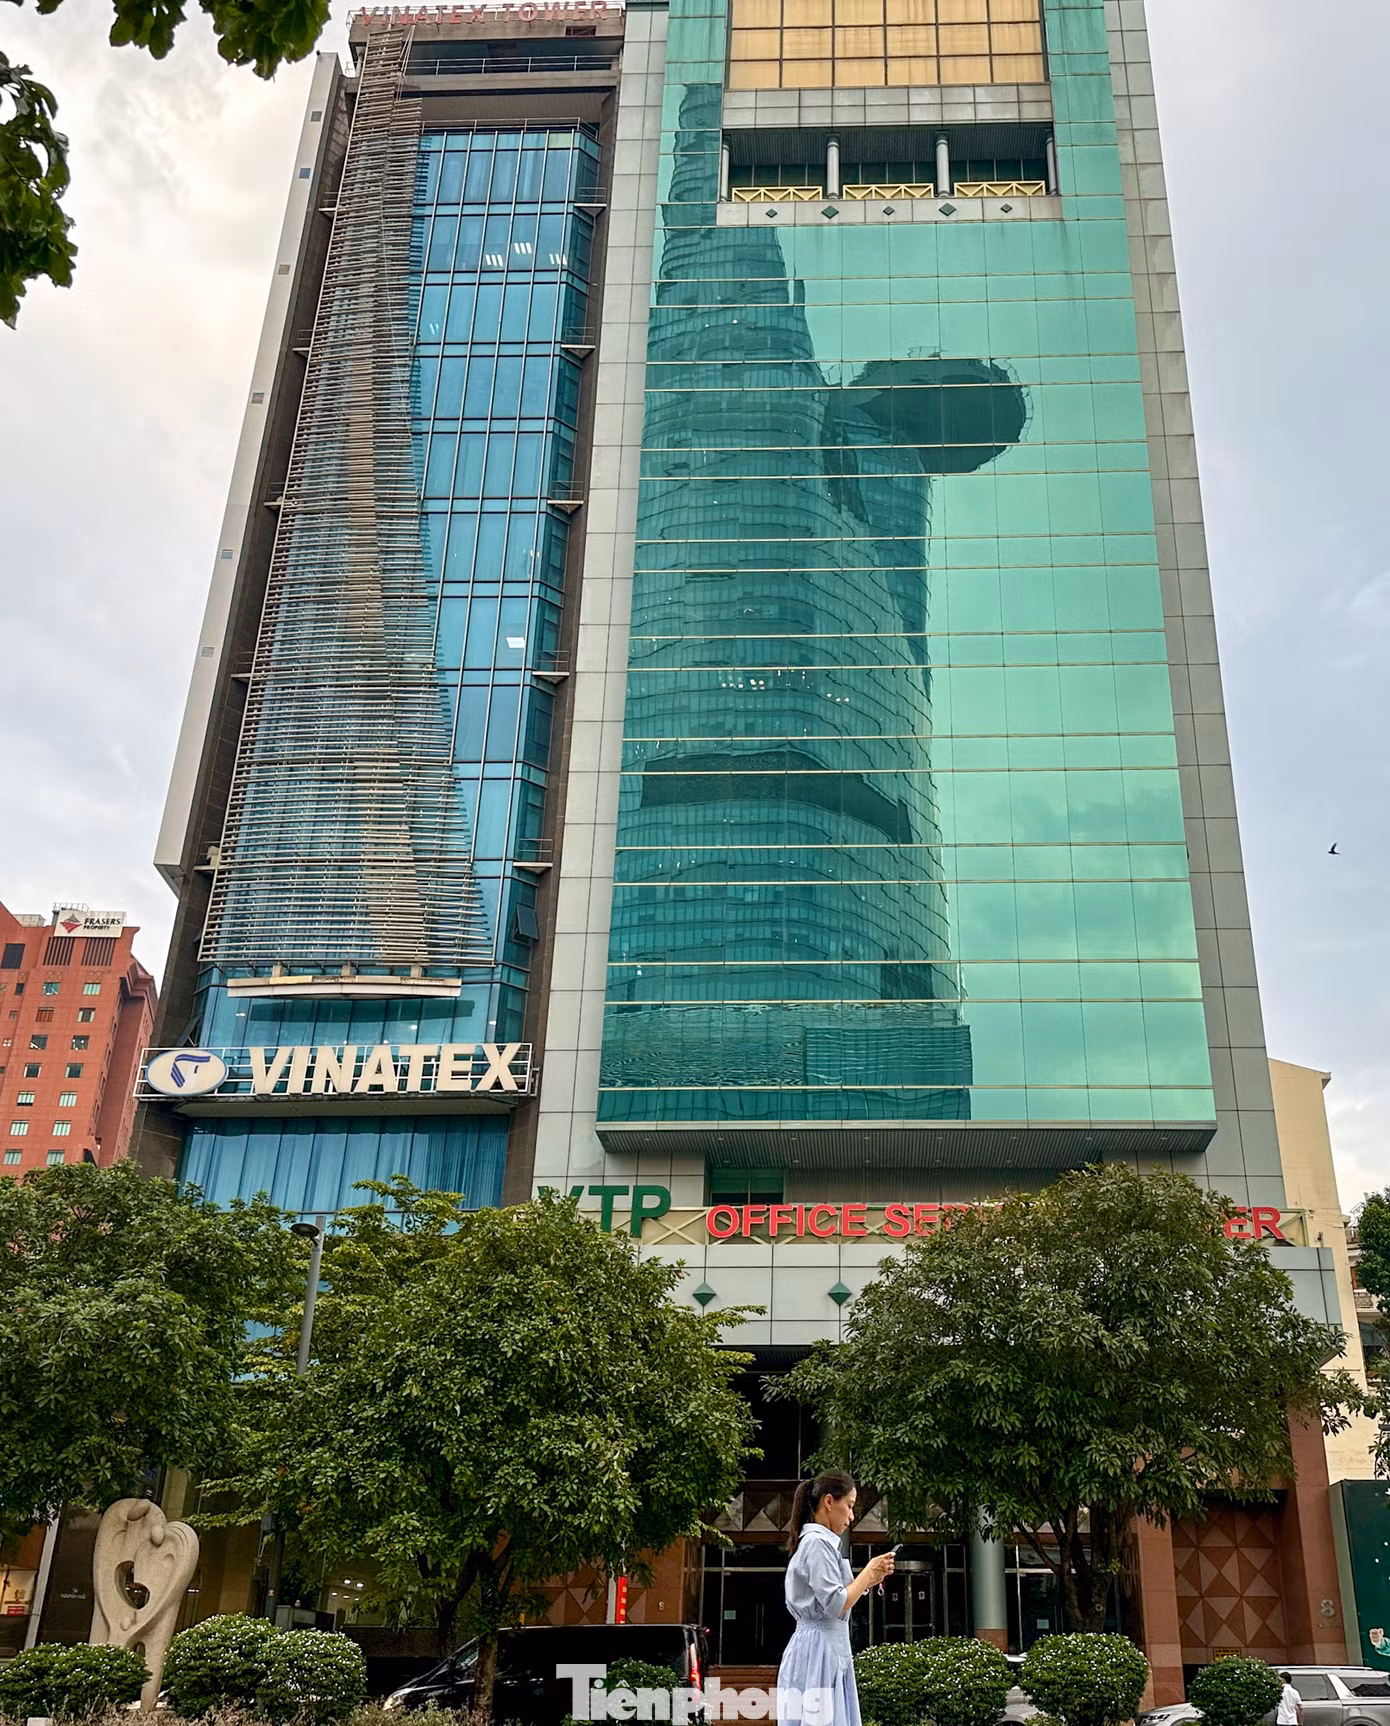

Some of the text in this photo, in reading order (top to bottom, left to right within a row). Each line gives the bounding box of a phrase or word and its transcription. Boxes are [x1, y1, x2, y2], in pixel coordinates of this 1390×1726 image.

[360, 1, 609, 26] VINATEX TOWER
[250, 1042, 522, 1094] VINATEX
[706, 1204, 867, 1238] OFFICE
